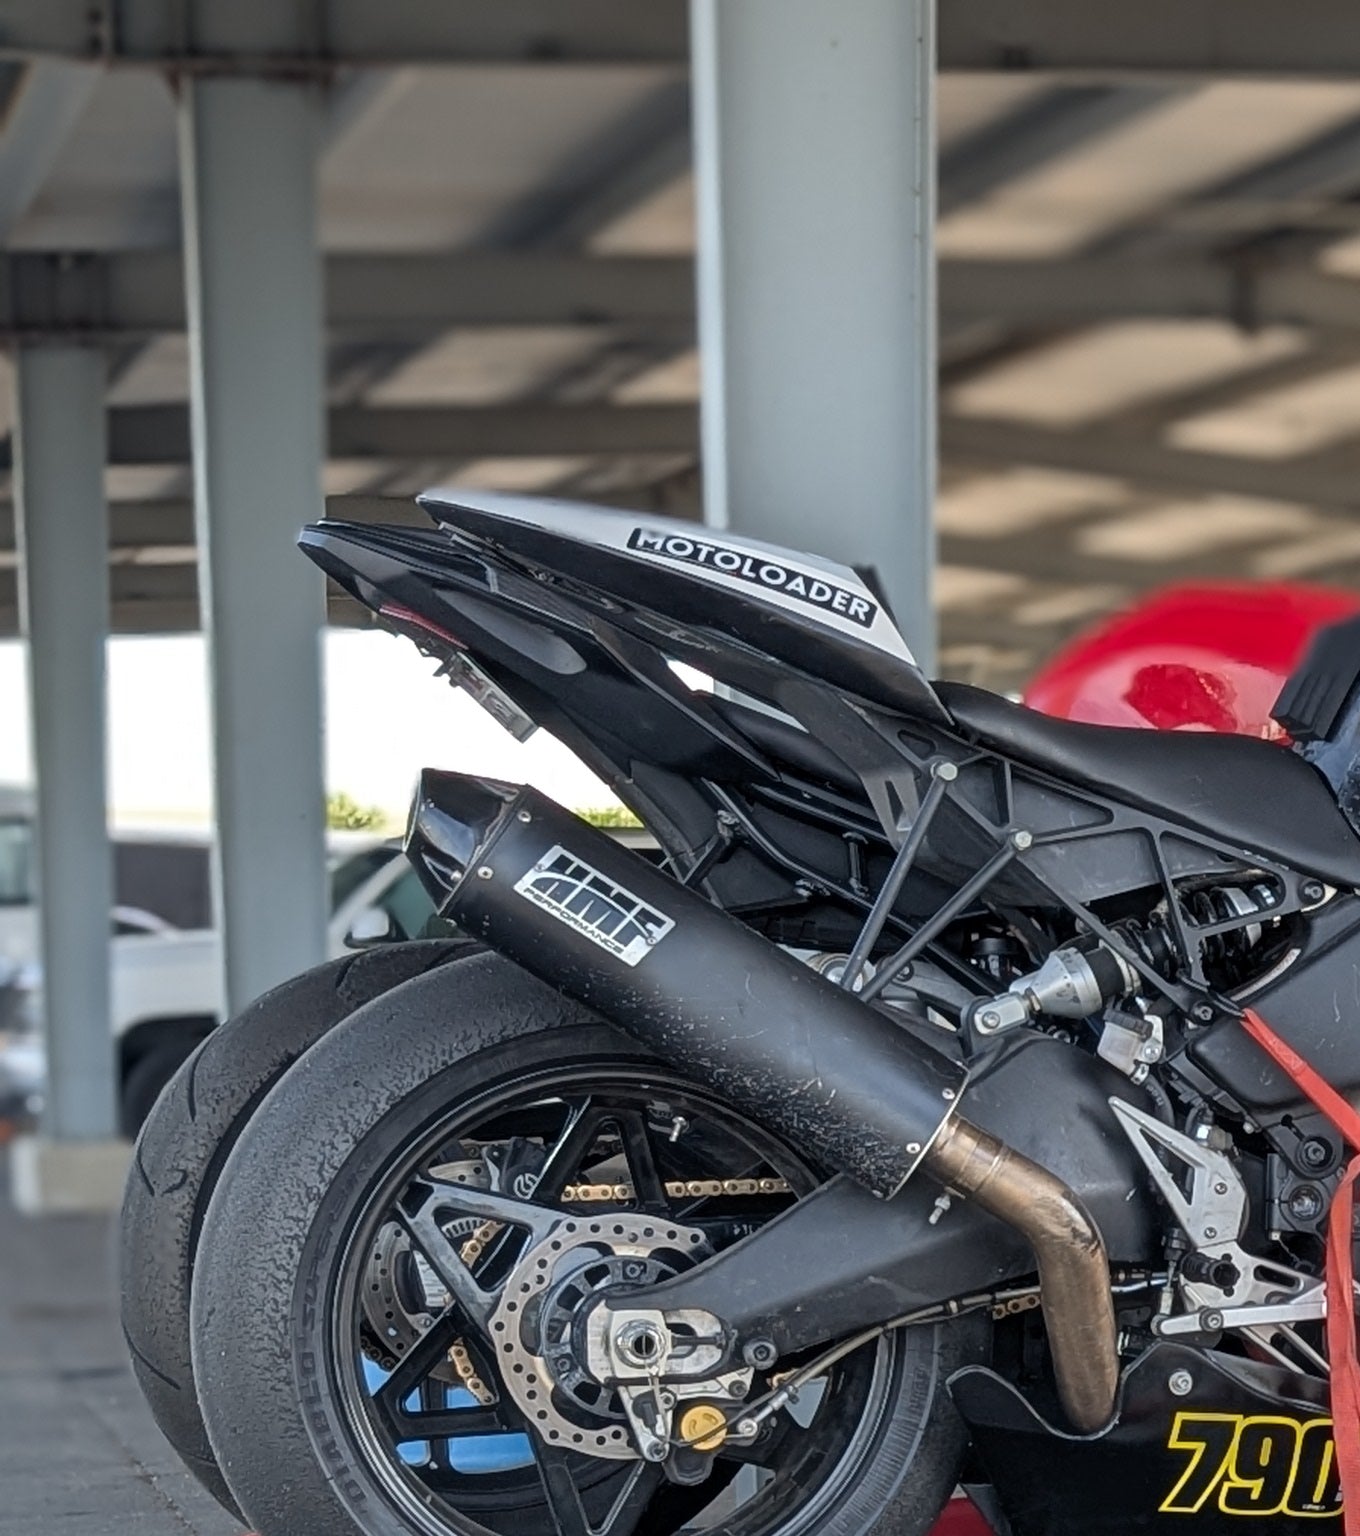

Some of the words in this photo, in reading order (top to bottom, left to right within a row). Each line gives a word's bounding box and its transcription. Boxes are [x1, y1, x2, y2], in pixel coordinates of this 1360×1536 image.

[636, 530, 872, 621] MOTOLOADER
[523, 887, 625, 955] PERFORMANCE
[529, 853, 667, 948] HMF
